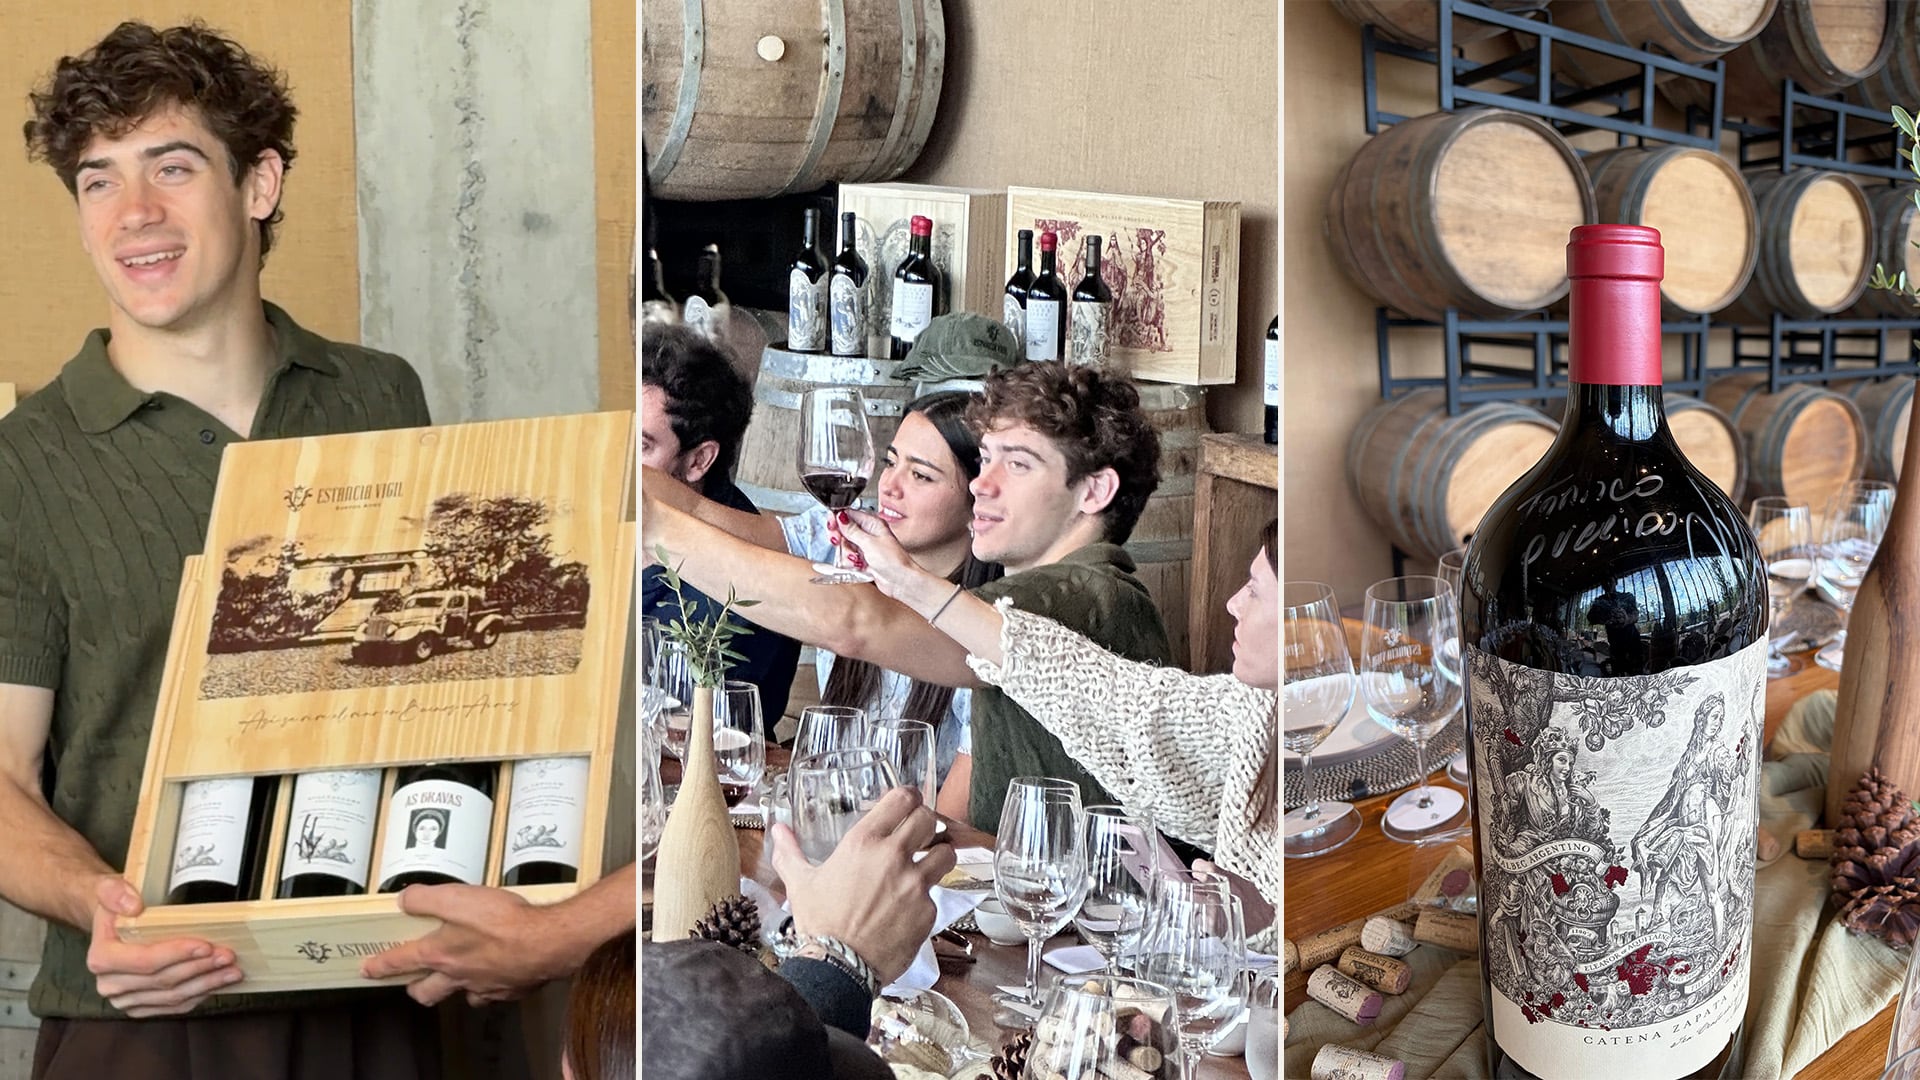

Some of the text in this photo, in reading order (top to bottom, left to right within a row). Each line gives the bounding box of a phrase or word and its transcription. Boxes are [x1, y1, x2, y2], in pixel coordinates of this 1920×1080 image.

[316, 481, 404, 504] ESTANCIA VIGIL
[420, 791, 463, 807] BRAVAS
[1529, 842, 1591, 867] ARGENTINO
[1584, 954, 1619, 972] ELEANOR
[1627, 933, 1671, 952] AQUITAINE
[1583, 1031, 1662, 1046] CATENA
[1672, 995, 1727, 1034] ZAPATA
